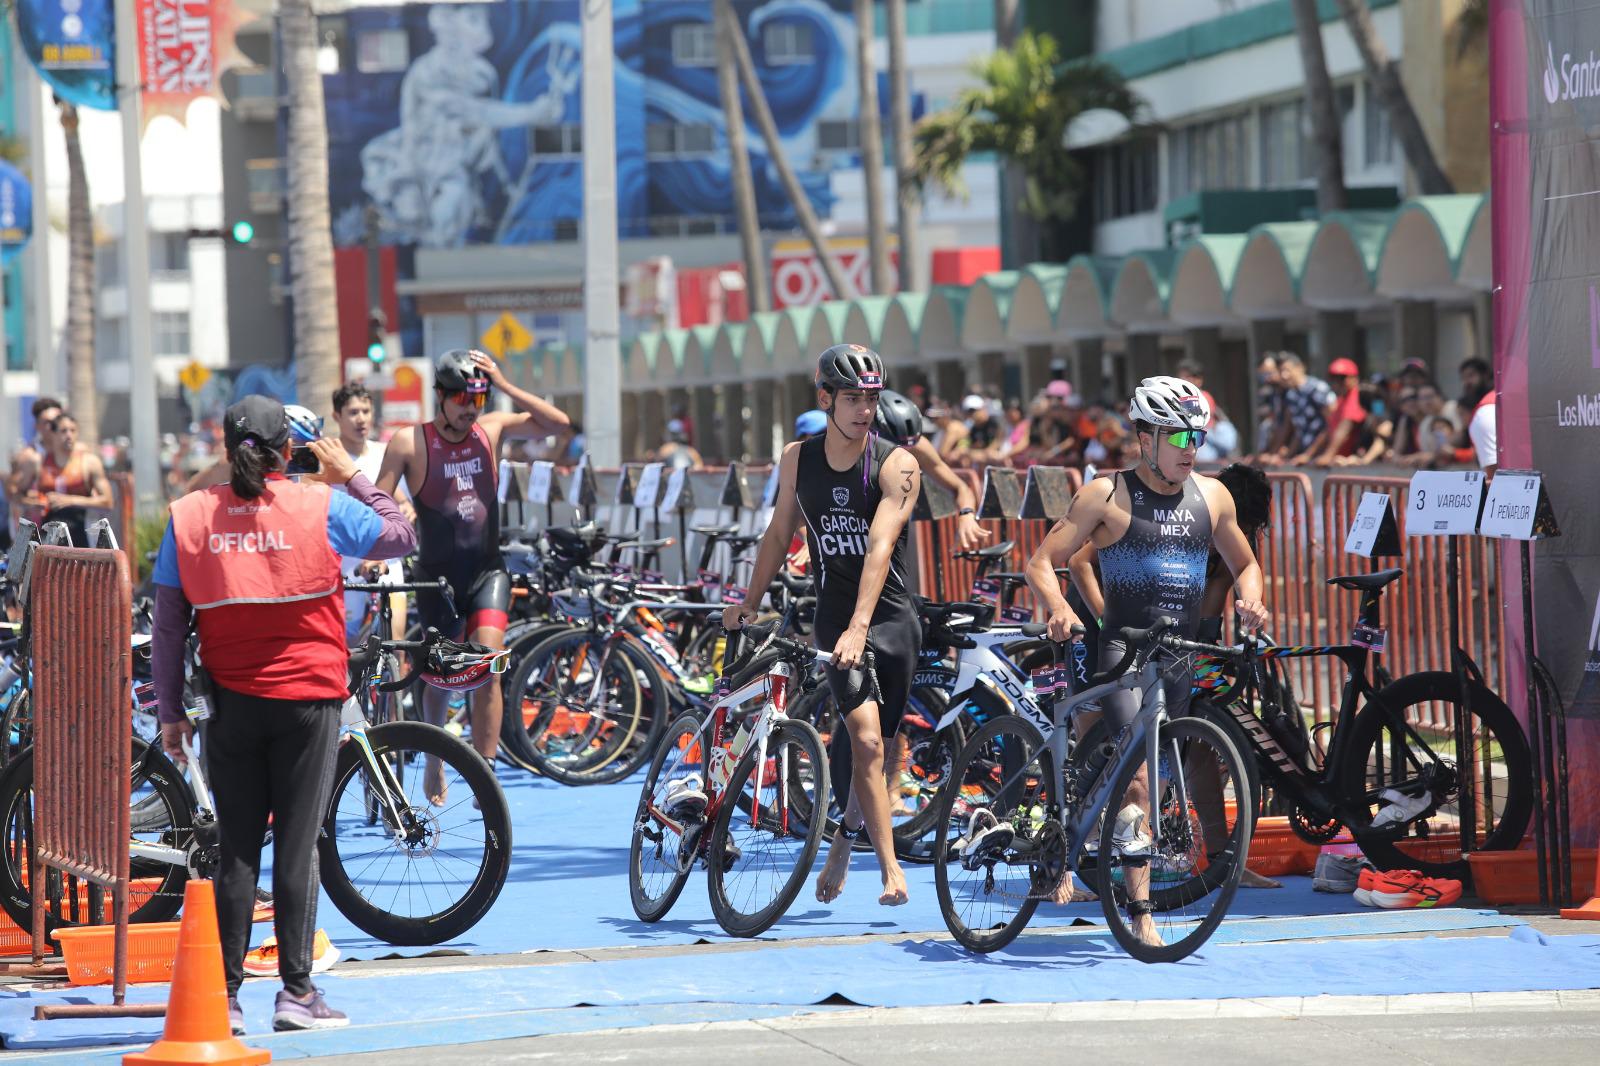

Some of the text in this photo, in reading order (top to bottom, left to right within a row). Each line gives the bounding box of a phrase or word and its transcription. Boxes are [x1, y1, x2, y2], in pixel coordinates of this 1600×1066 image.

[444, 457, 483, 479] MARTINEZ
[1416, 489, 1473, 511] 3 VARGAS
[1490, 497, 1531, 521] 1 PEÑAFLOR
[820, 514, 870, 534] GARCIA
[1153, 508, 1196, 523] MAYA
[1160, 524, 1191, 537] MEX
[208, 529, 293, 555] OFICIAL
